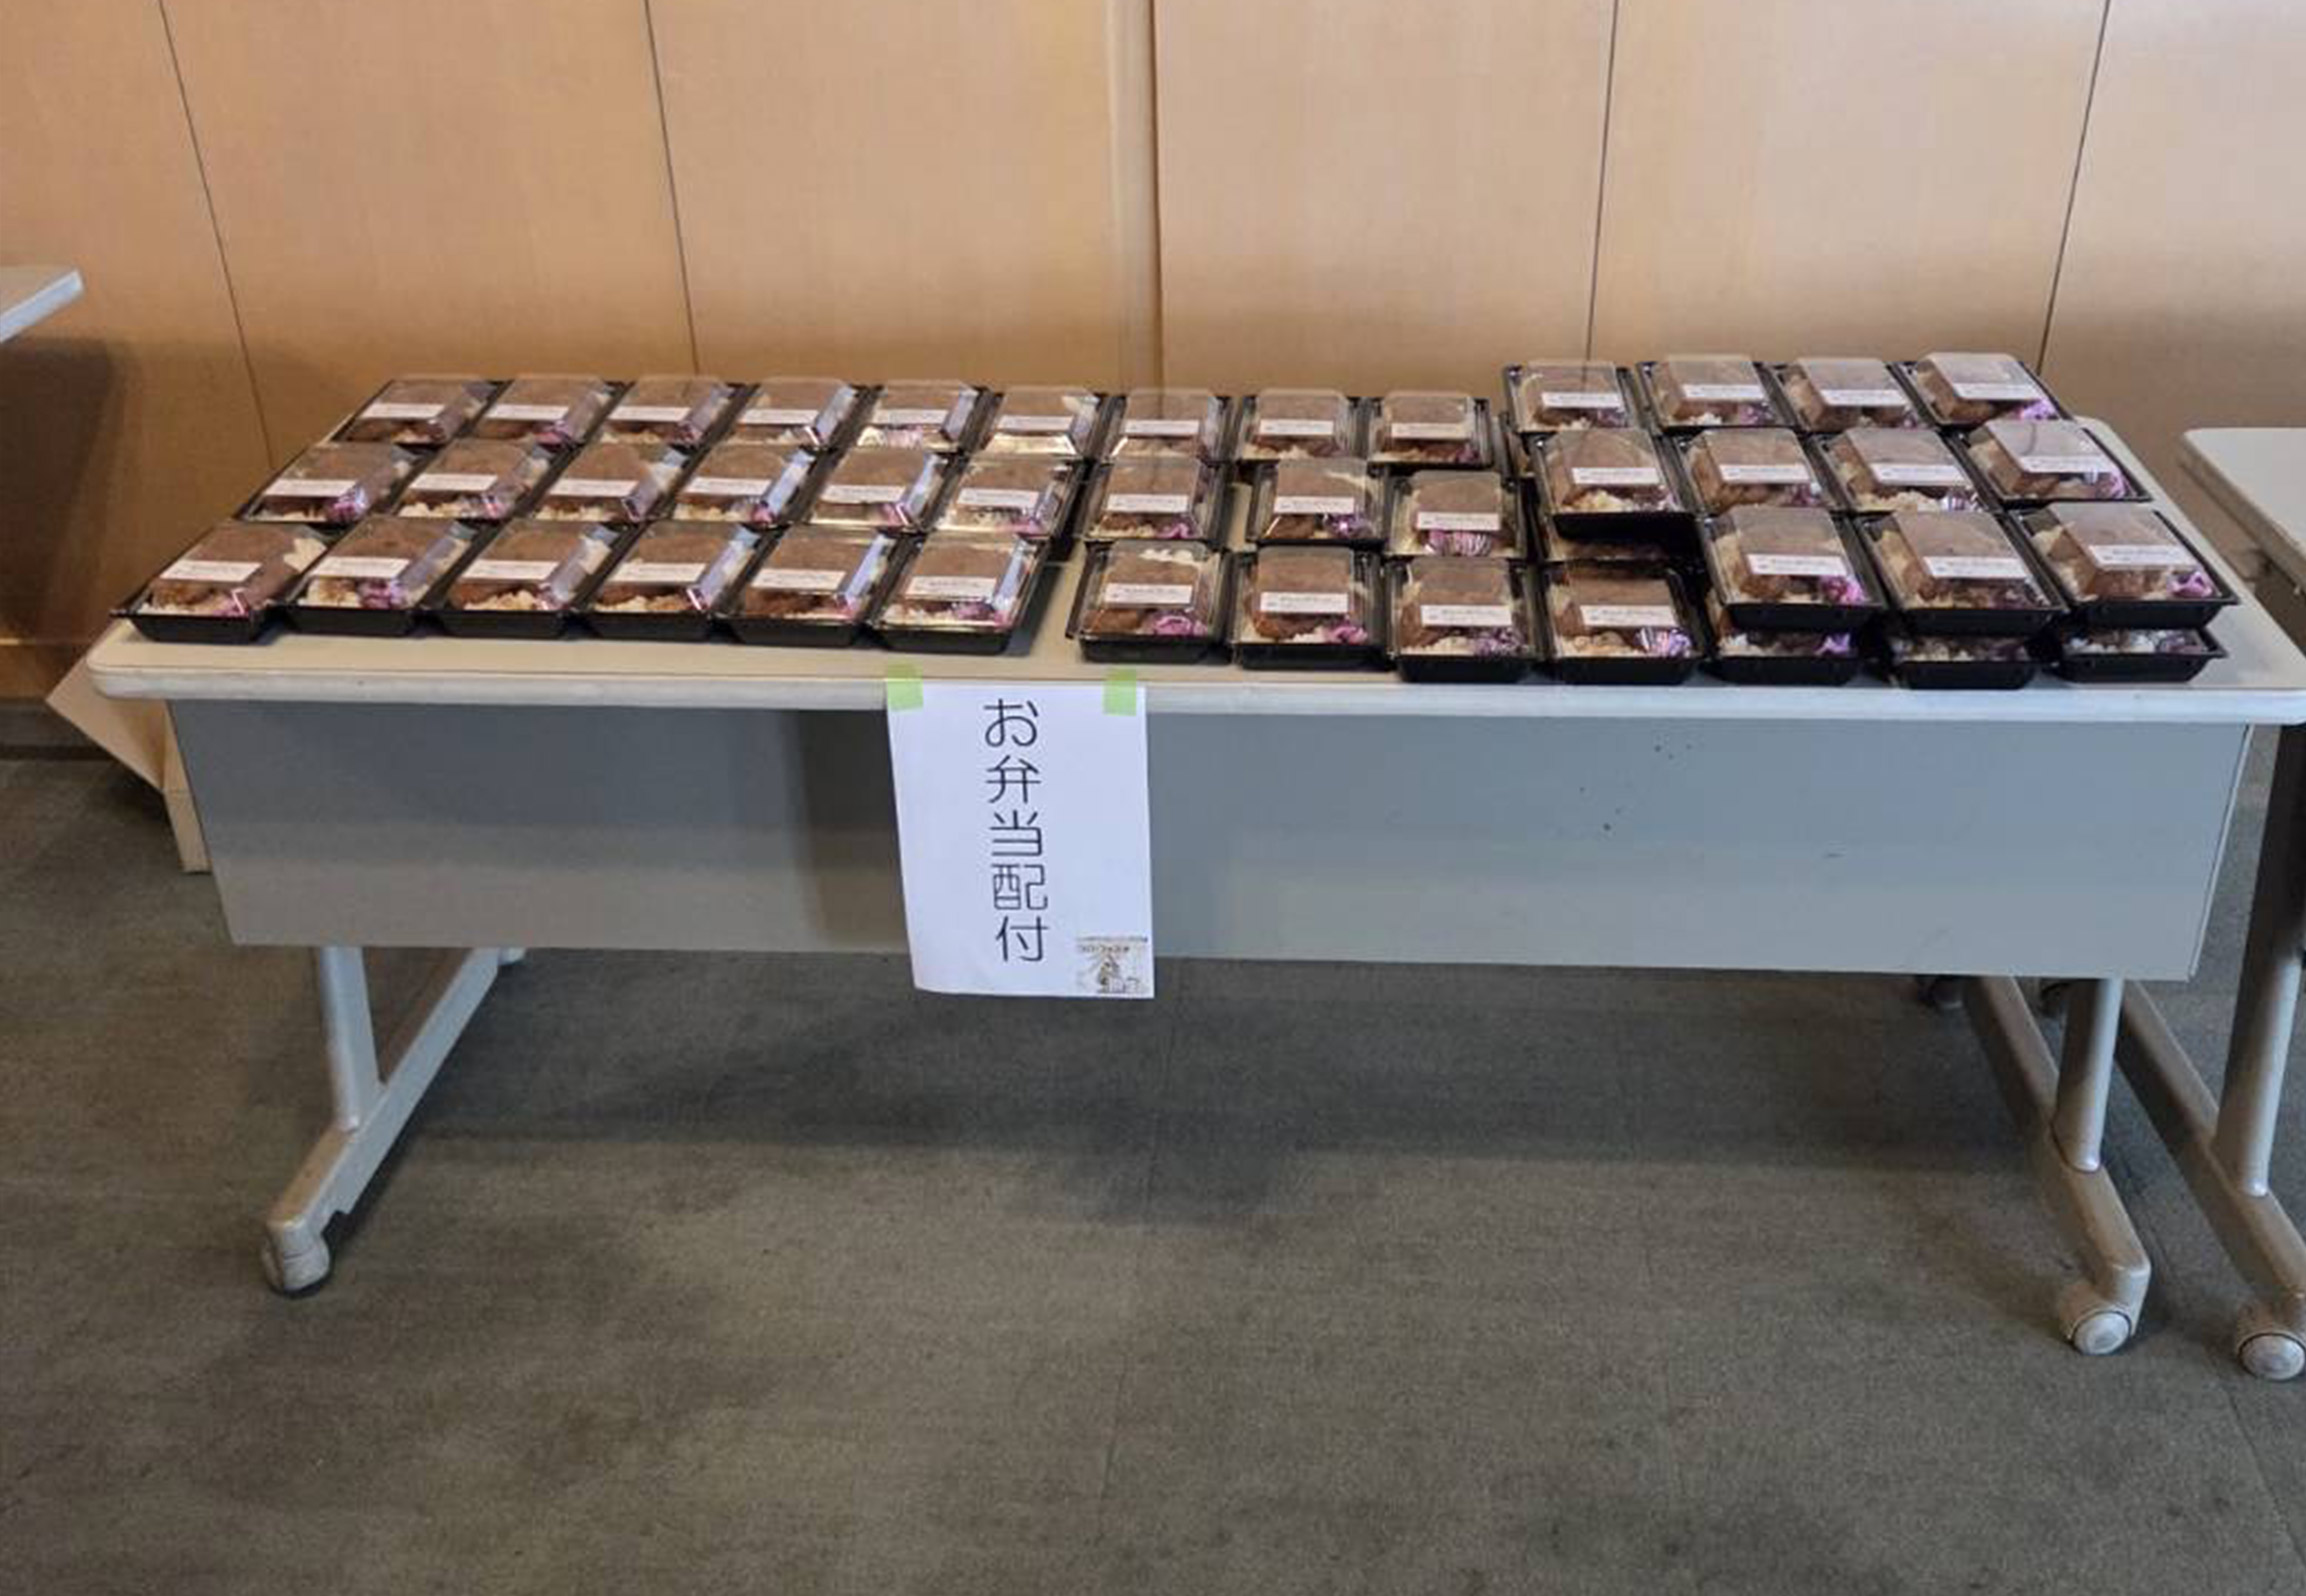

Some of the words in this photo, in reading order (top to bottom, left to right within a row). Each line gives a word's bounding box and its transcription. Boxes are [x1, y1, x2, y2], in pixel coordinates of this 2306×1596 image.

[984, 698, 1050, 962] お弁当配付
